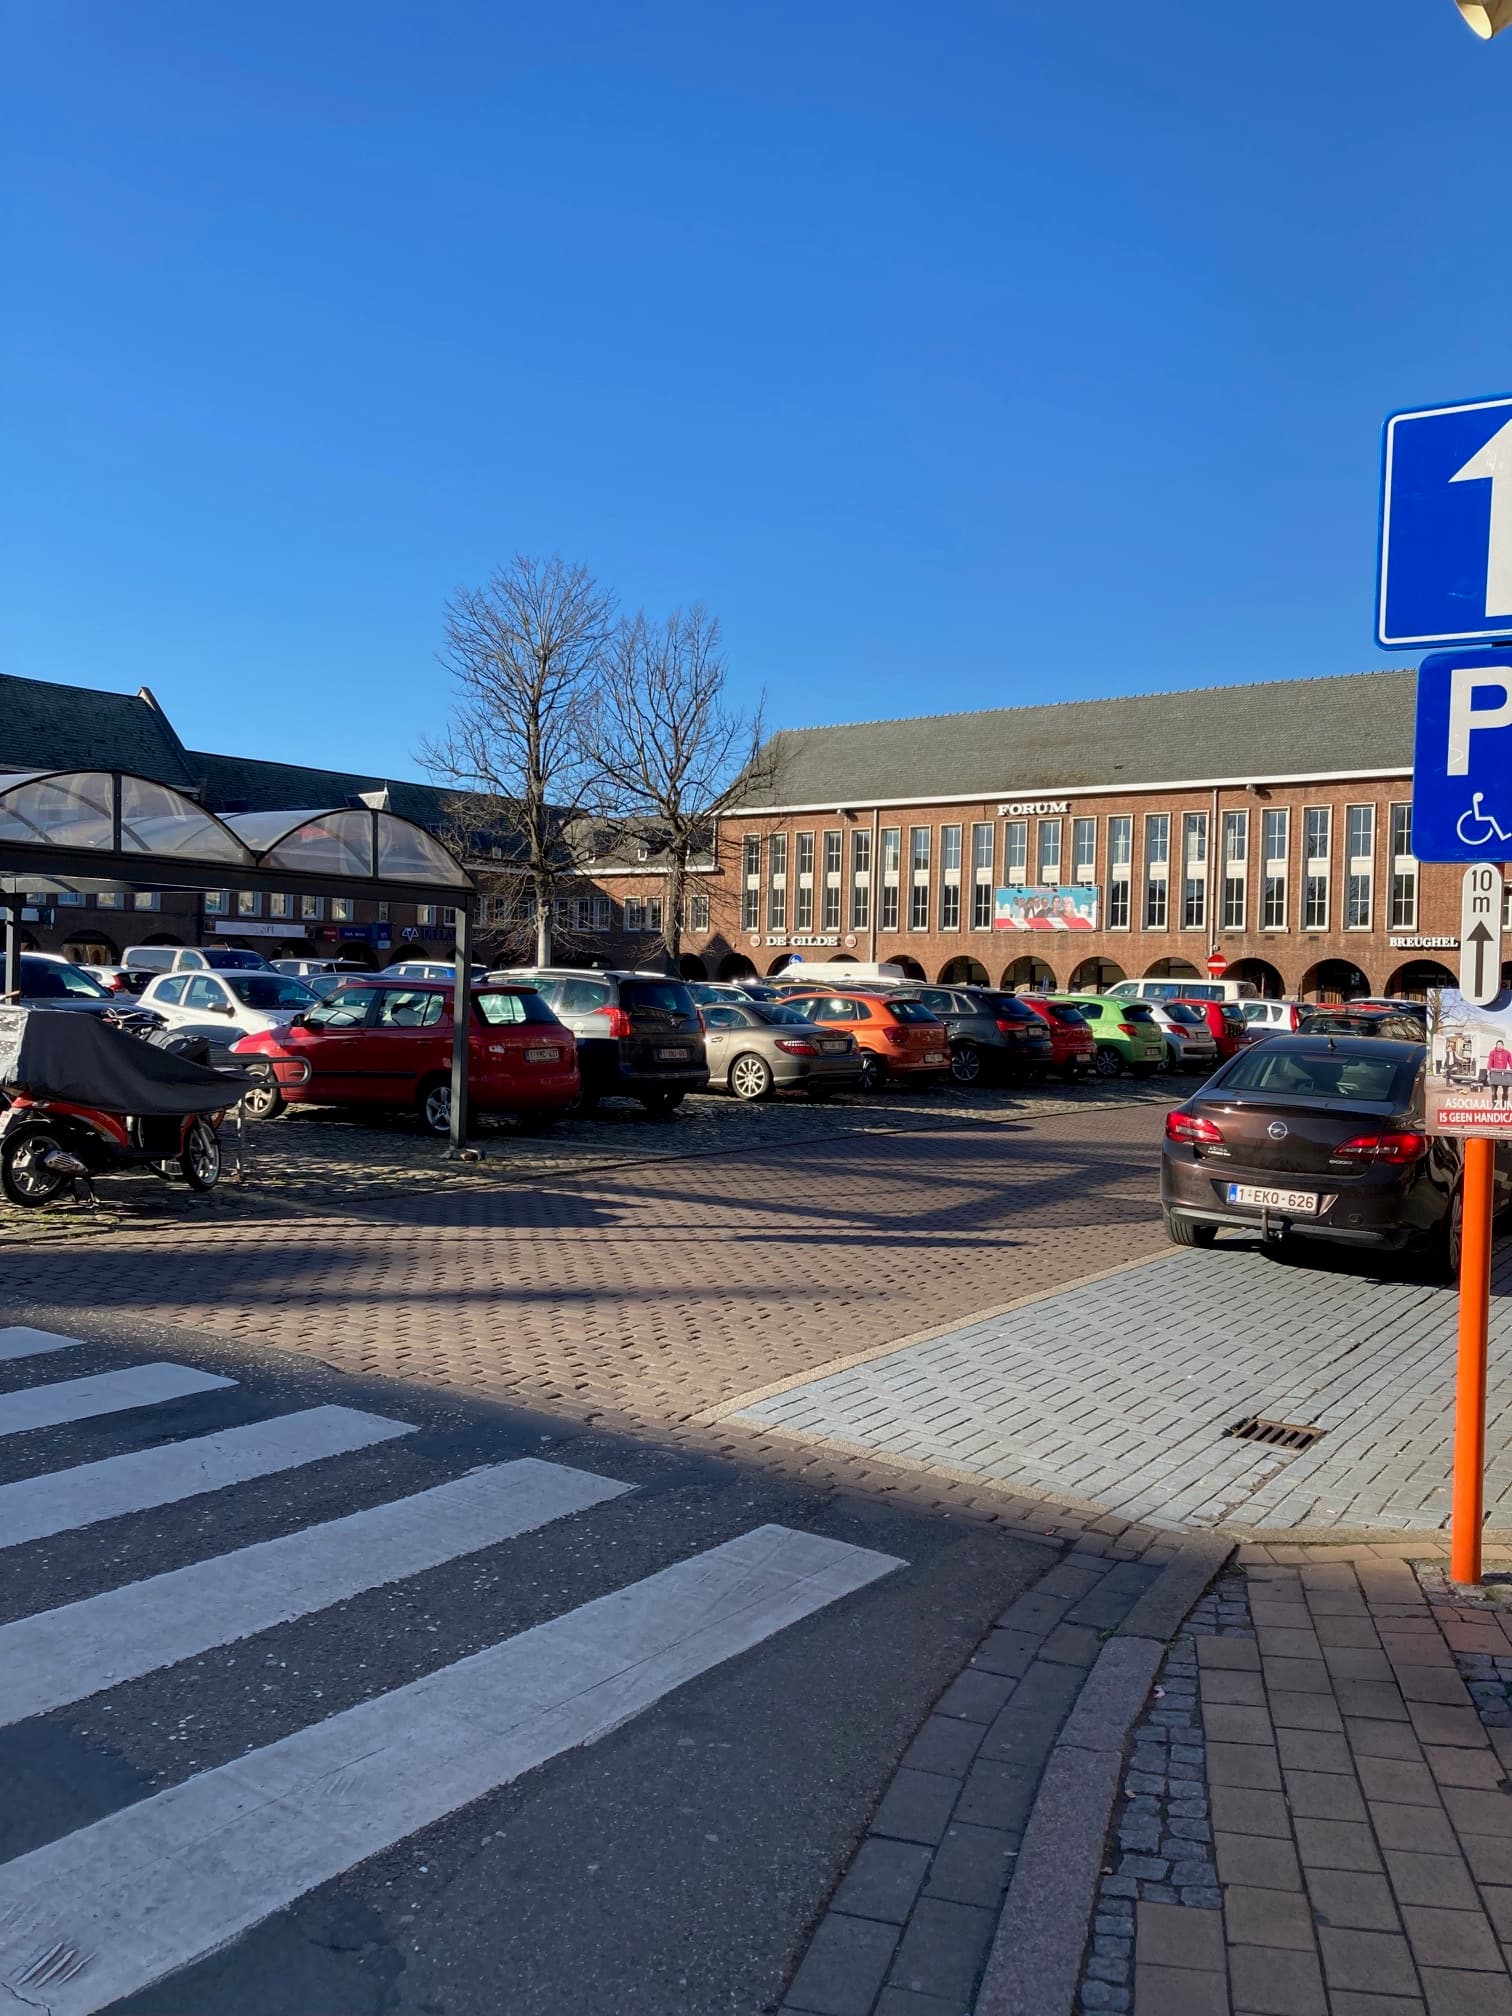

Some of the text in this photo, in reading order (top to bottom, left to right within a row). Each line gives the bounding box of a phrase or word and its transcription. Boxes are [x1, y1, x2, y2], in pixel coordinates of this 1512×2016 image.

[1447, 666, 1512, 776] P
[997, 801, 1068, 816] FORUM
[1471, 869, 1493, 892] 10
[1472, 896, 1490, 913] m
[765, 936, 838, 946] DE GILDE
[1389, 937, 1459, 948] BREUGHEL
[1445, 1098, 1492, 1110] ASOCIAAL
[1440, 1112, 1448, 1123] IS
[1449, 1112, 1473, 1123] GEEN
